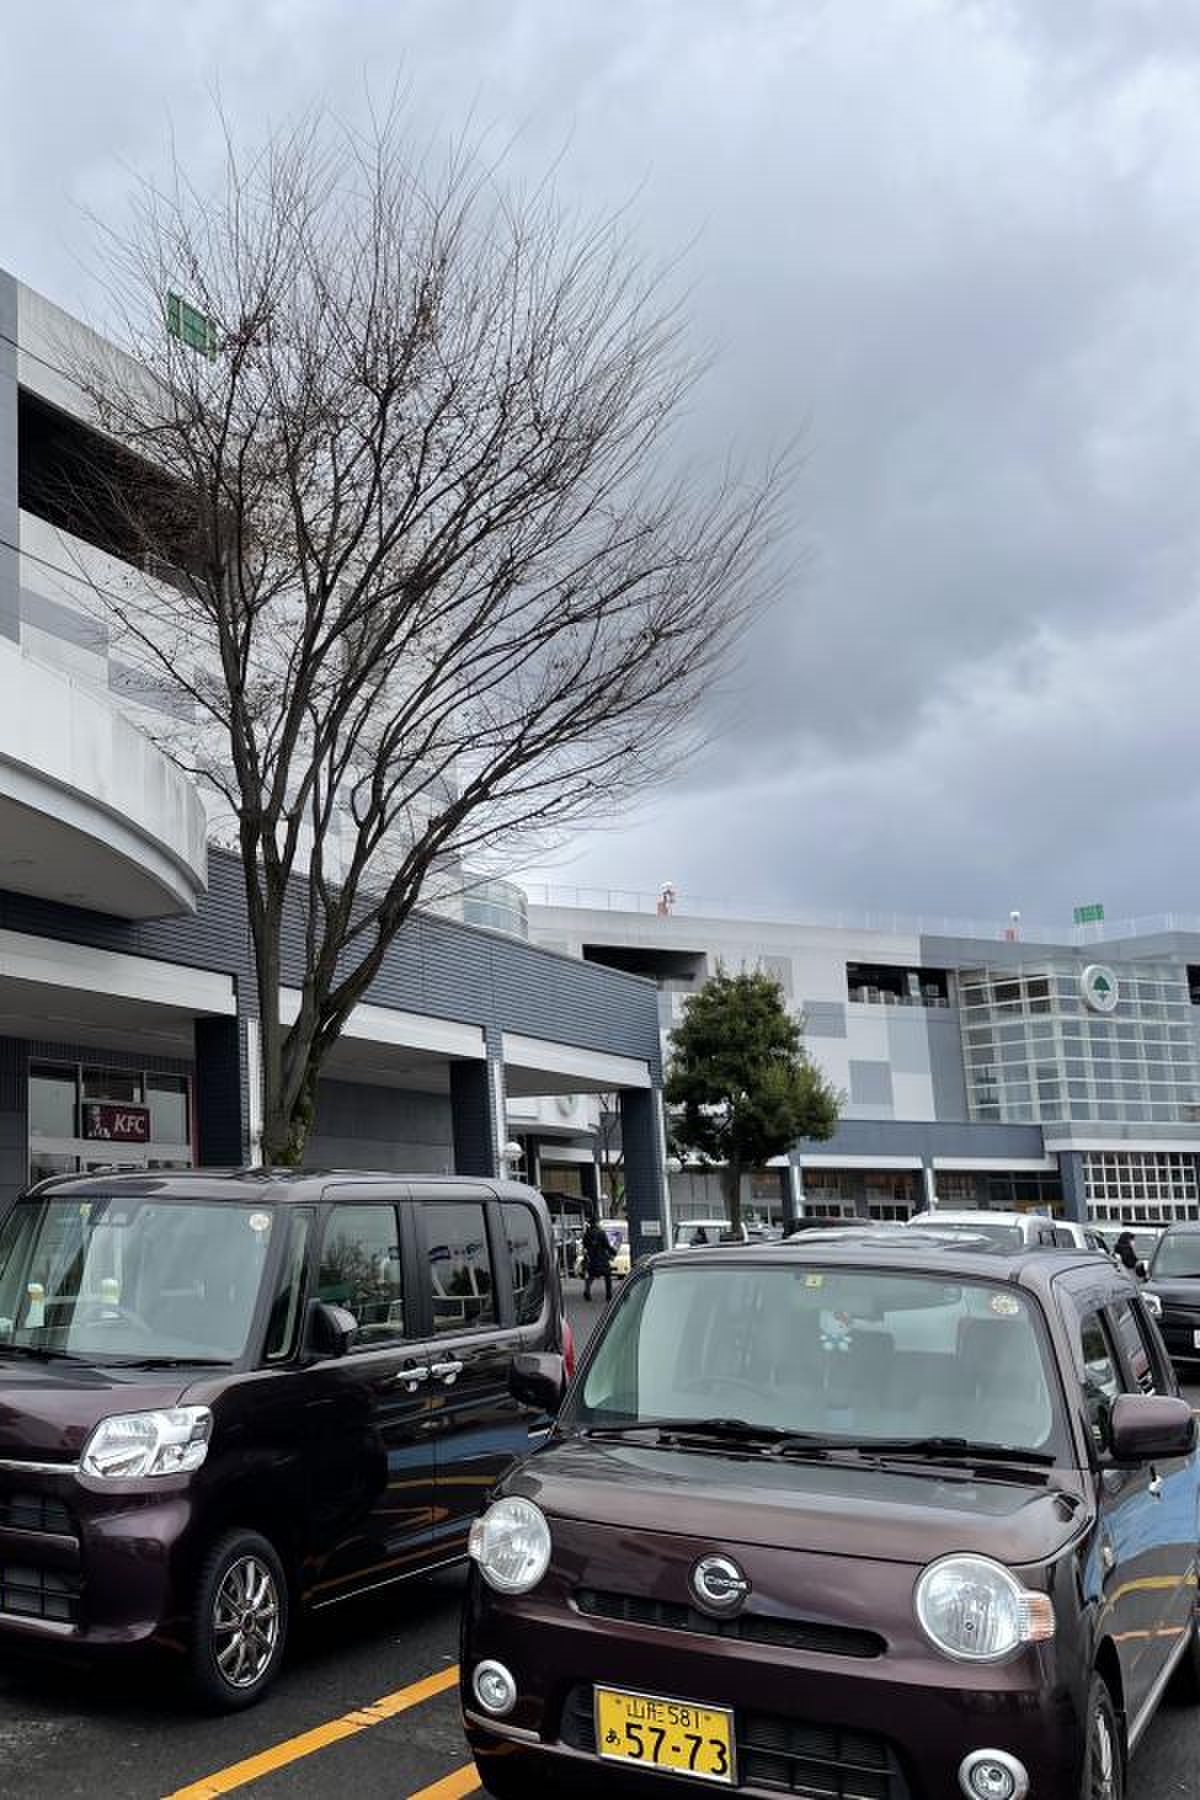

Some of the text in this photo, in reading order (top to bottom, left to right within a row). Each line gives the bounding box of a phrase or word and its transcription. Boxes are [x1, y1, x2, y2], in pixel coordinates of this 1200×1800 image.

[113, 1113, 146, 1134] KFC
[626, 1699, 700, 1729] 山形 581
[625, 1722, 728, 1775] 57-73
